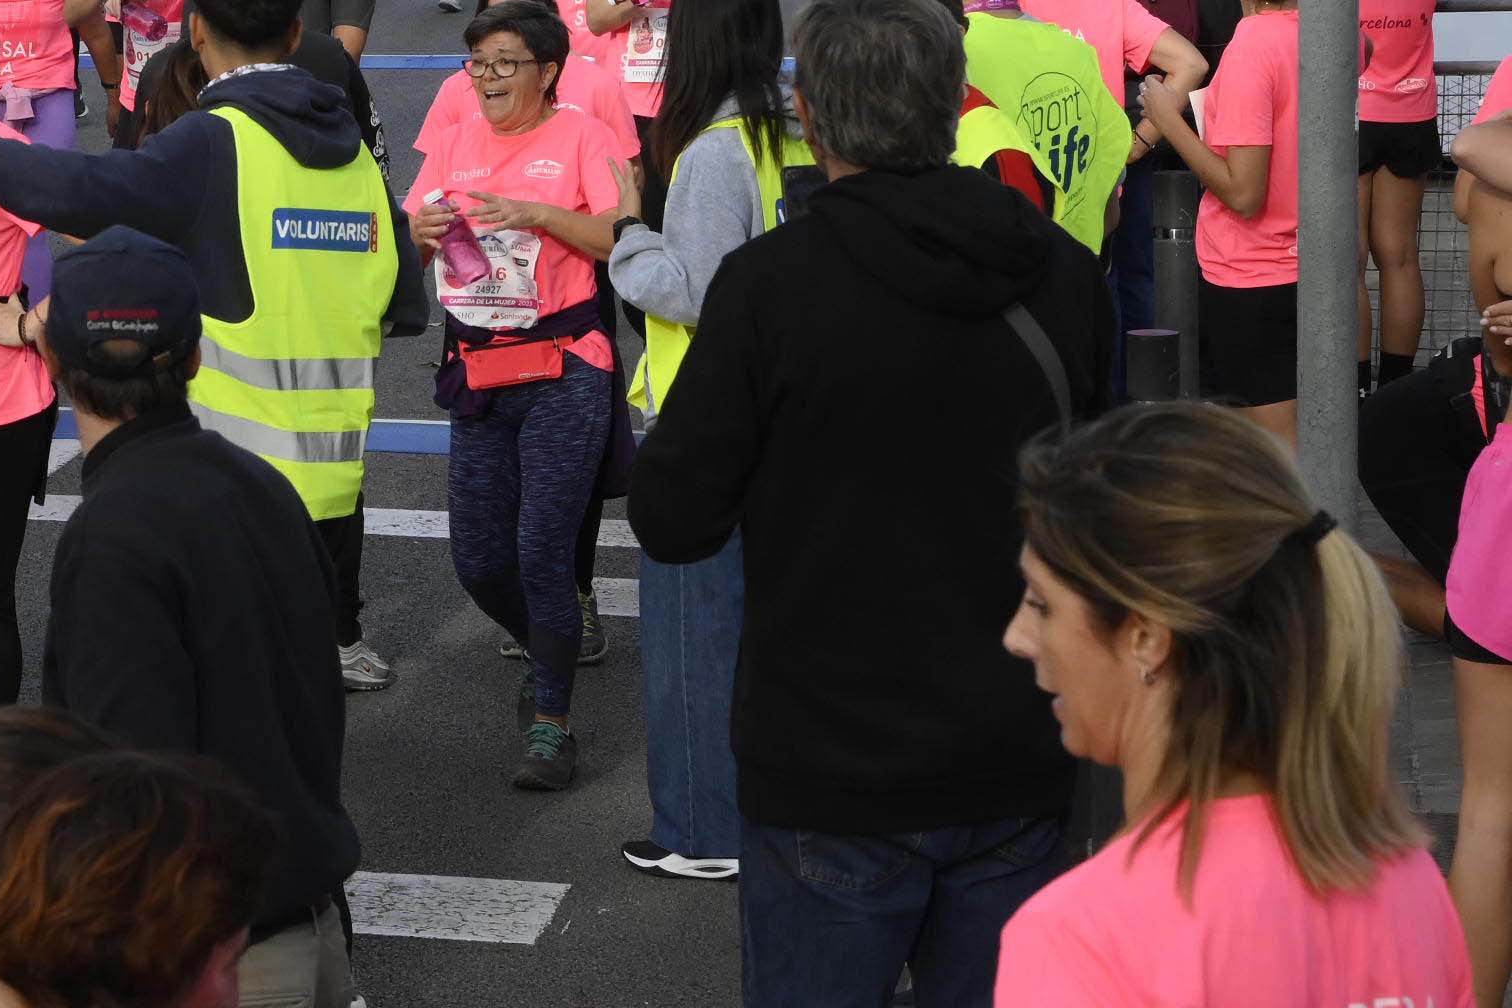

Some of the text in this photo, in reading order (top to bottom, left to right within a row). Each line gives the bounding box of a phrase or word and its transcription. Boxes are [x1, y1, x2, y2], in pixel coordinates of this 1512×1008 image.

[1048, 126, 1089, 194] ife
[452, 167, 491, 182] OYSHO
[275, 219, 369, 242] VOLUNTARIS
[475, 285, 501, 295] 24927
